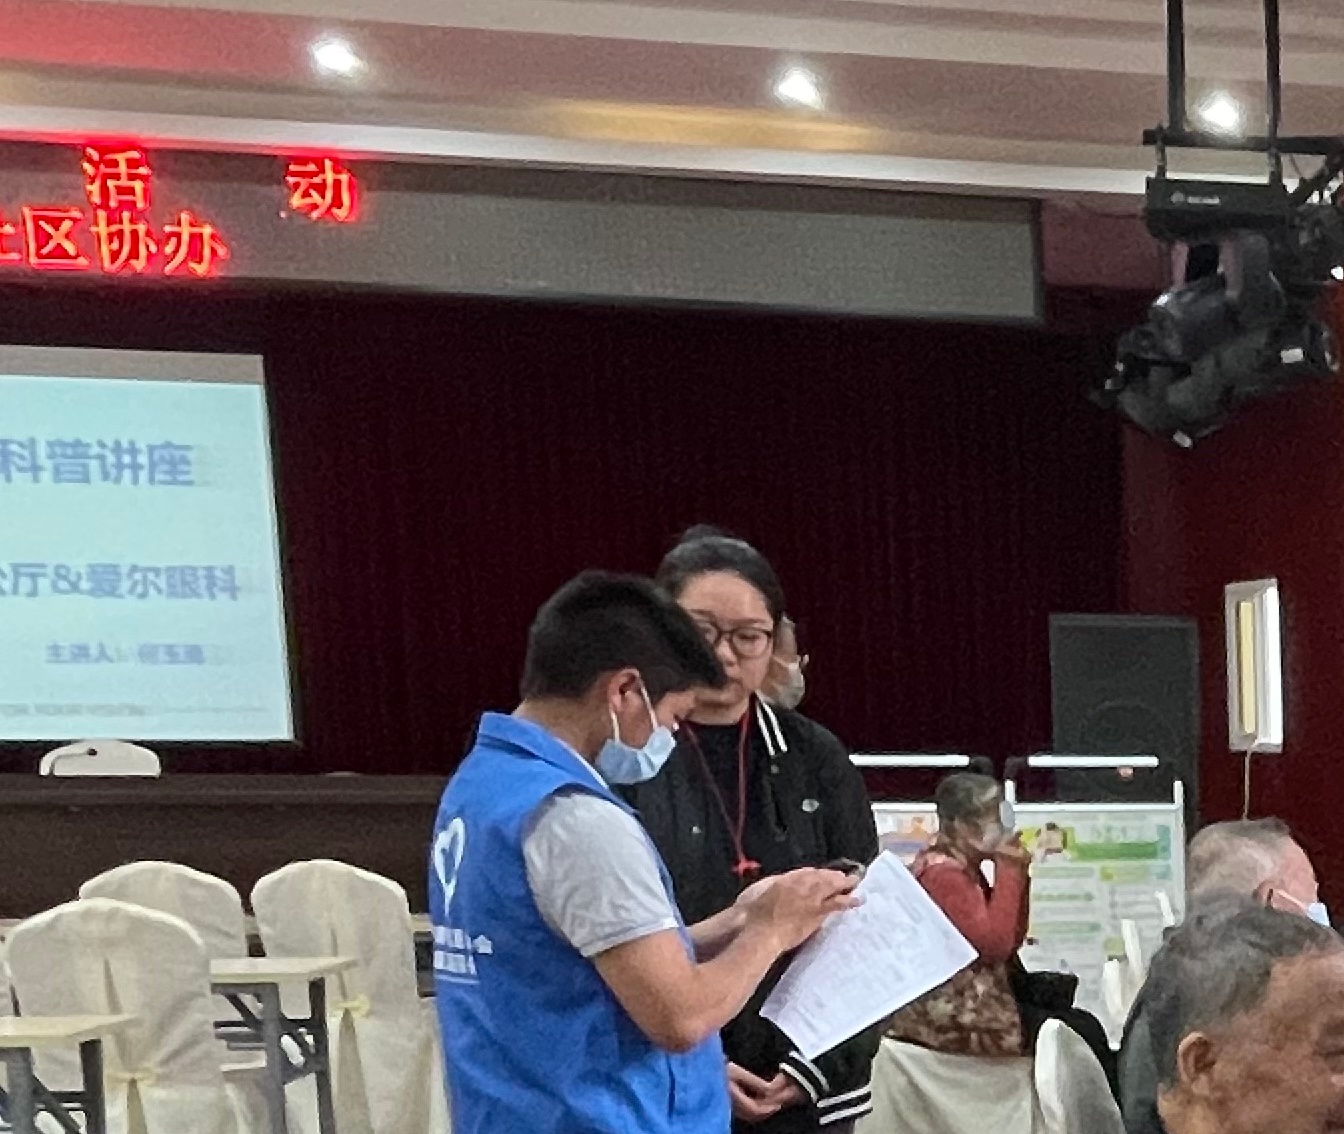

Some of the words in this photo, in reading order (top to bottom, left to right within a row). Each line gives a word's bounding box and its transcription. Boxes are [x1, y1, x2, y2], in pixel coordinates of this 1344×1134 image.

[82, 145, 151, 209] 活
[285, 157, 352, 221] 动
[0, 437, 195, 486] 科普讲座
